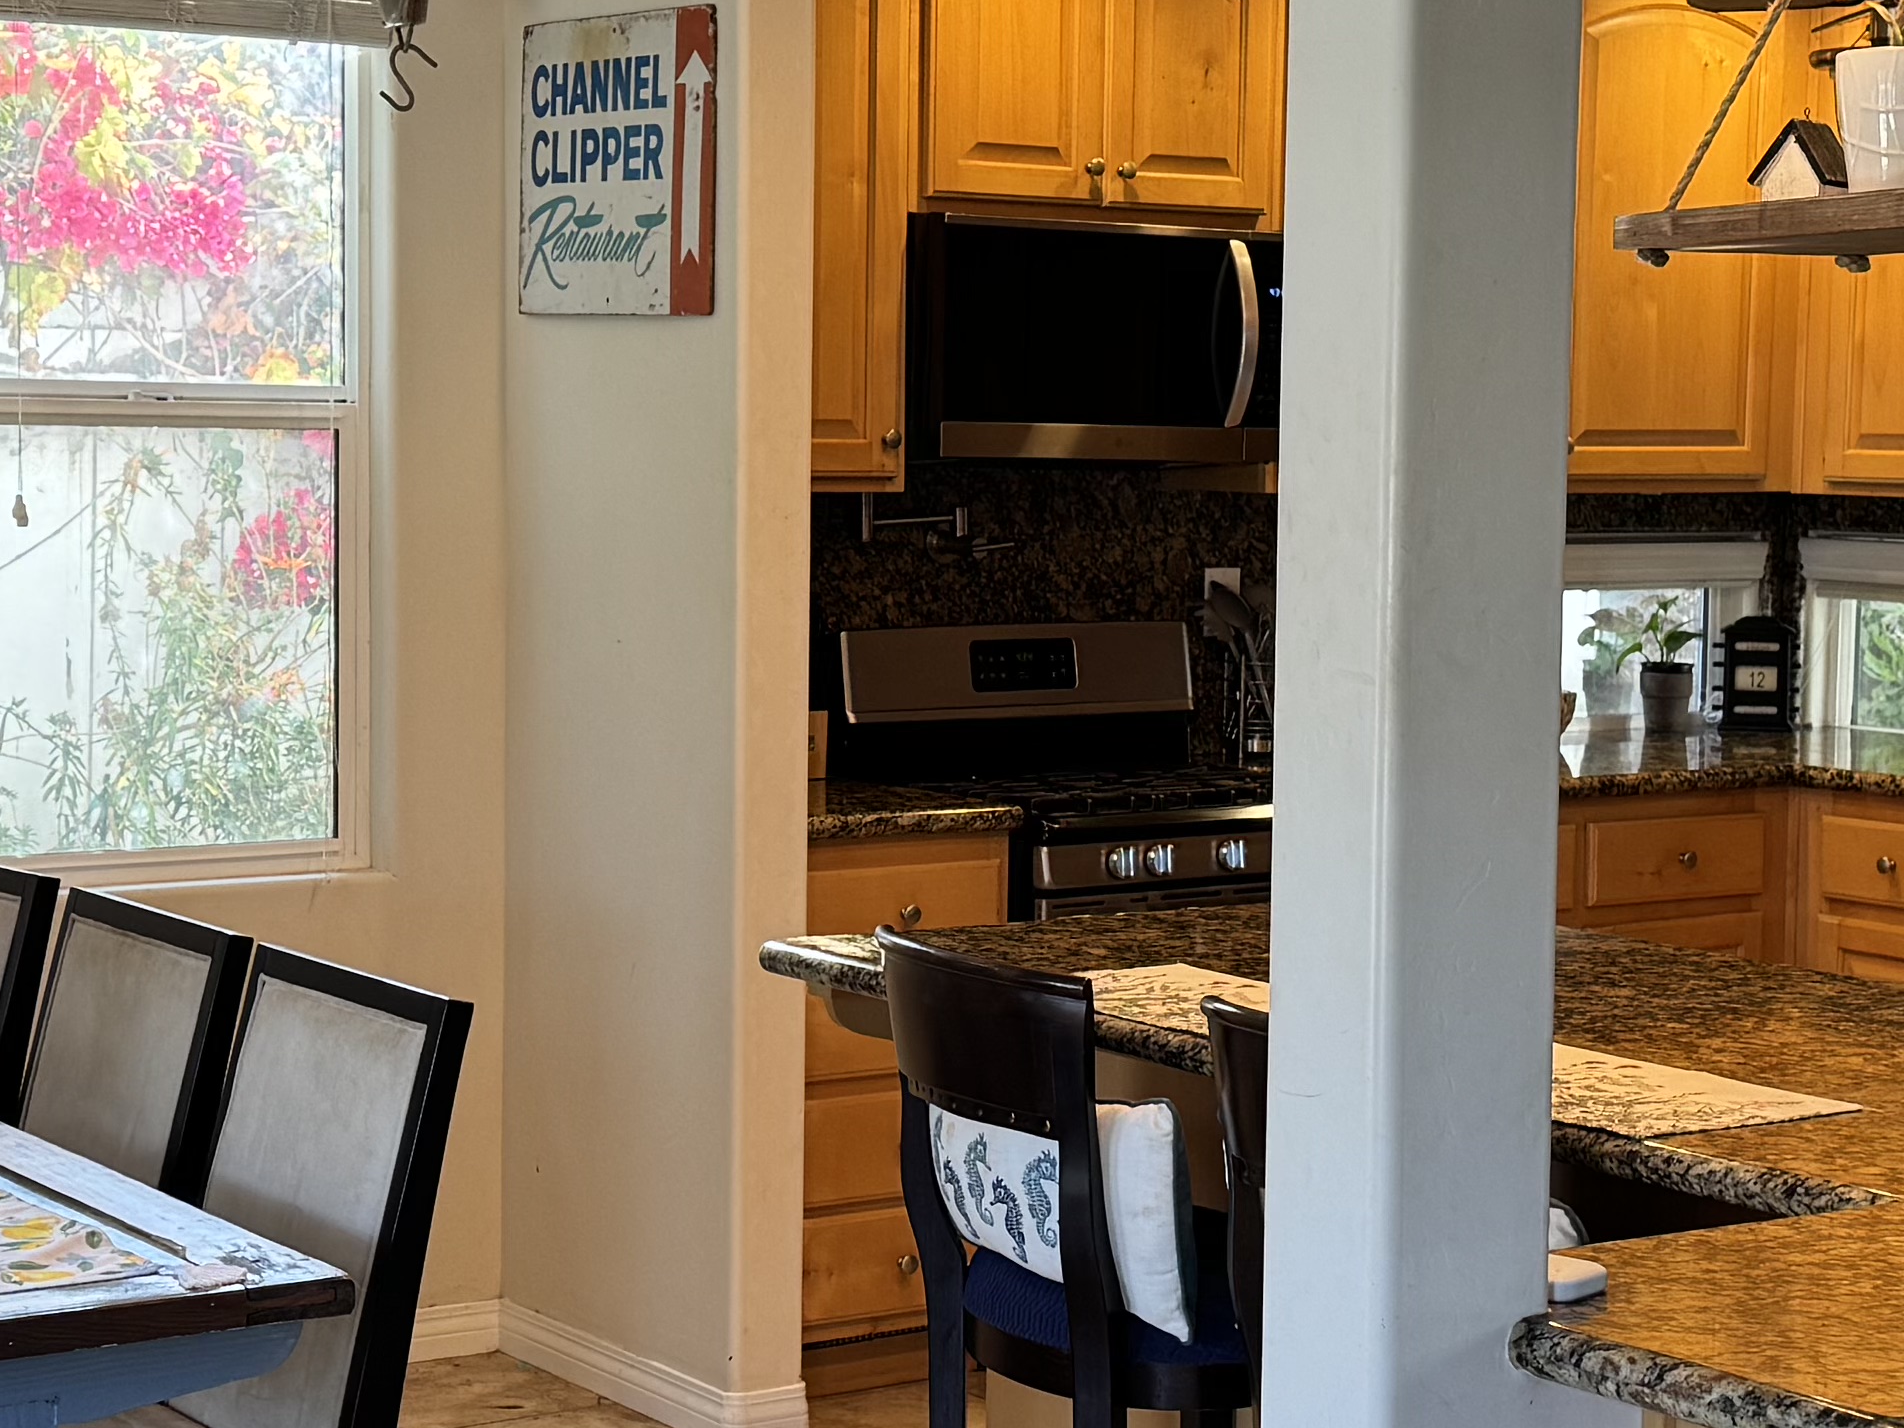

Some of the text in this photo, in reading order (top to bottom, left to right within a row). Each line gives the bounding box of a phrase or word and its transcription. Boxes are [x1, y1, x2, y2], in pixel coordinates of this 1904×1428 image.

[531, 54, 667, 118] CHANNEL
[531, 124, 663, 187] CLIPPER
[523, 195, 667, 290] Restaurant
[1750, 671, 1765, 688] 12
